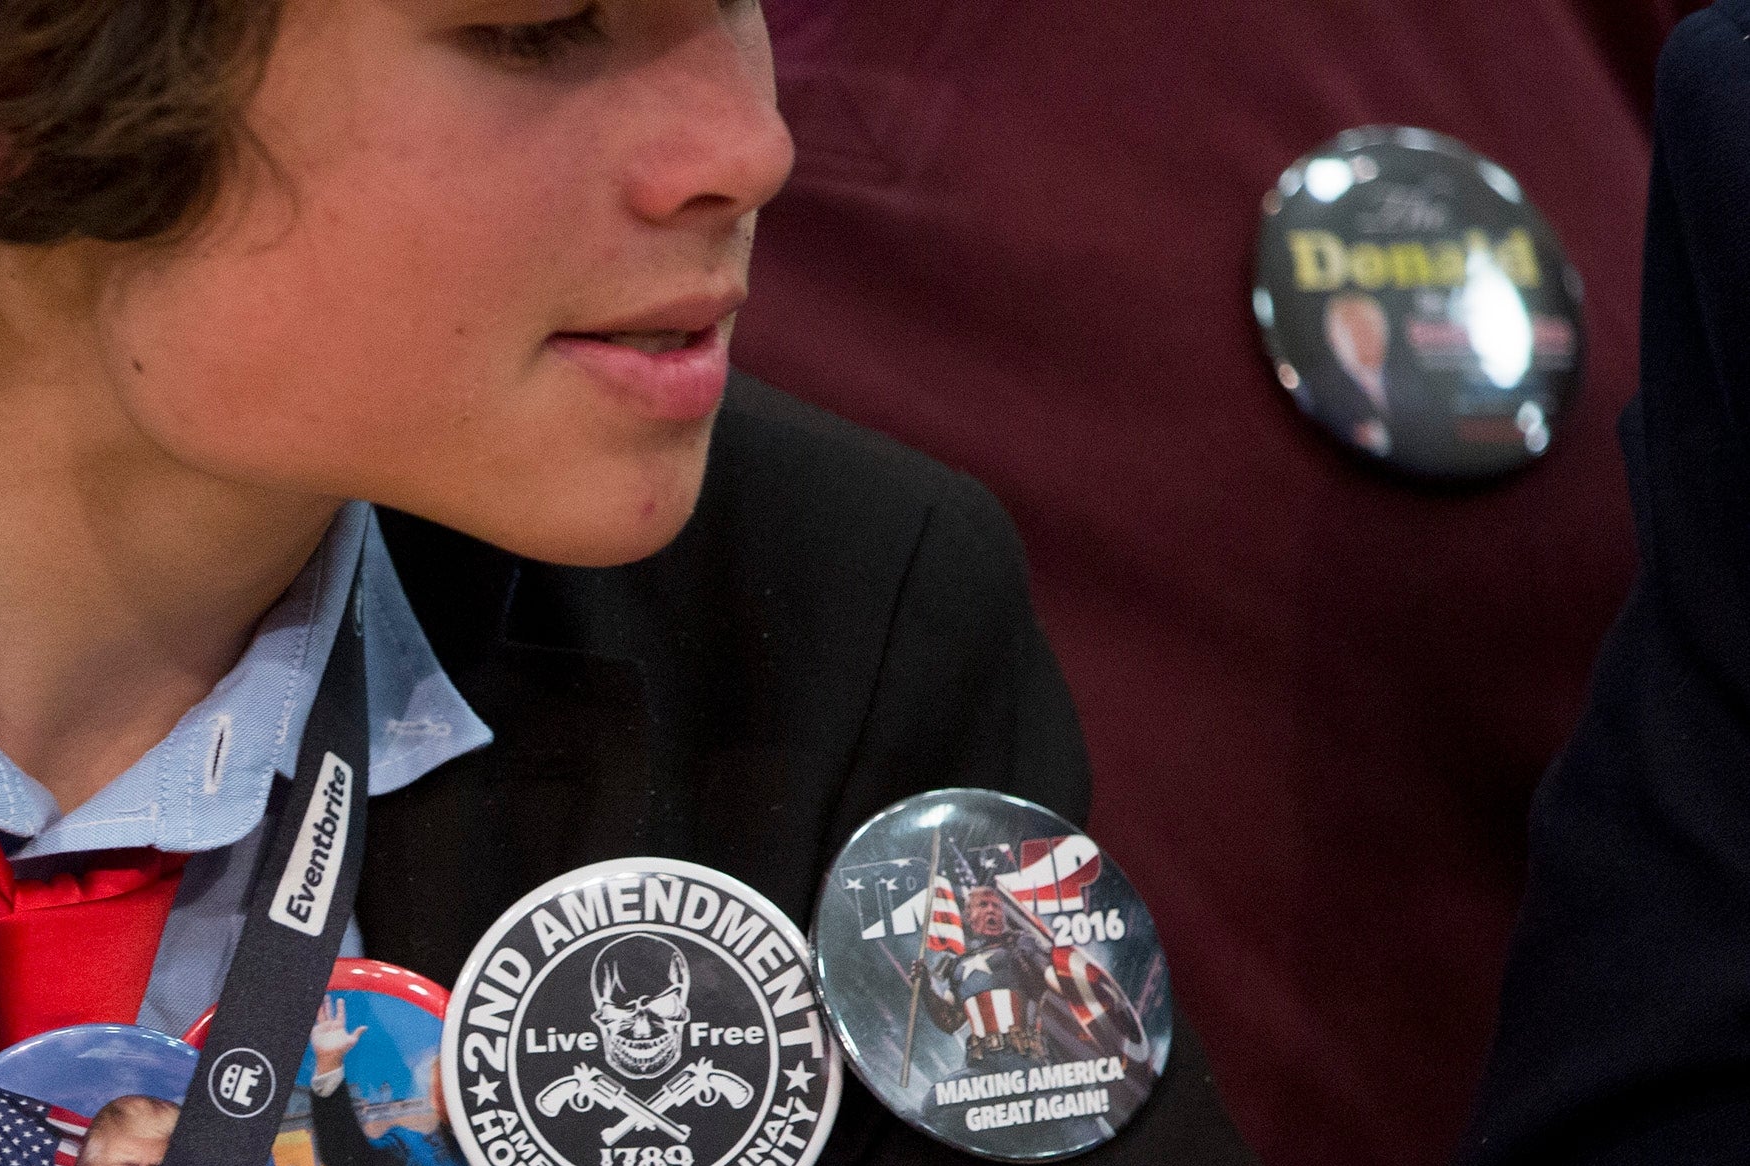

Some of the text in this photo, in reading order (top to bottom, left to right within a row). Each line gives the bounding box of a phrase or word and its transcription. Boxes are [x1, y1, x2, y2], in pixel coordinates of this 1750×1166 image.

[286, 765, 346, 924] Eventbrite
[1052, 909, 1126, 947] 2016
[463, 876, 824, 1074] 2ND AMENDMENT
[525, 1021, 765, 1054] Live Free
[935, 1056, 1126, 1107] MAKING AMERICA
[965, 1088, 1110, 1132] GREAT AGAIN!
